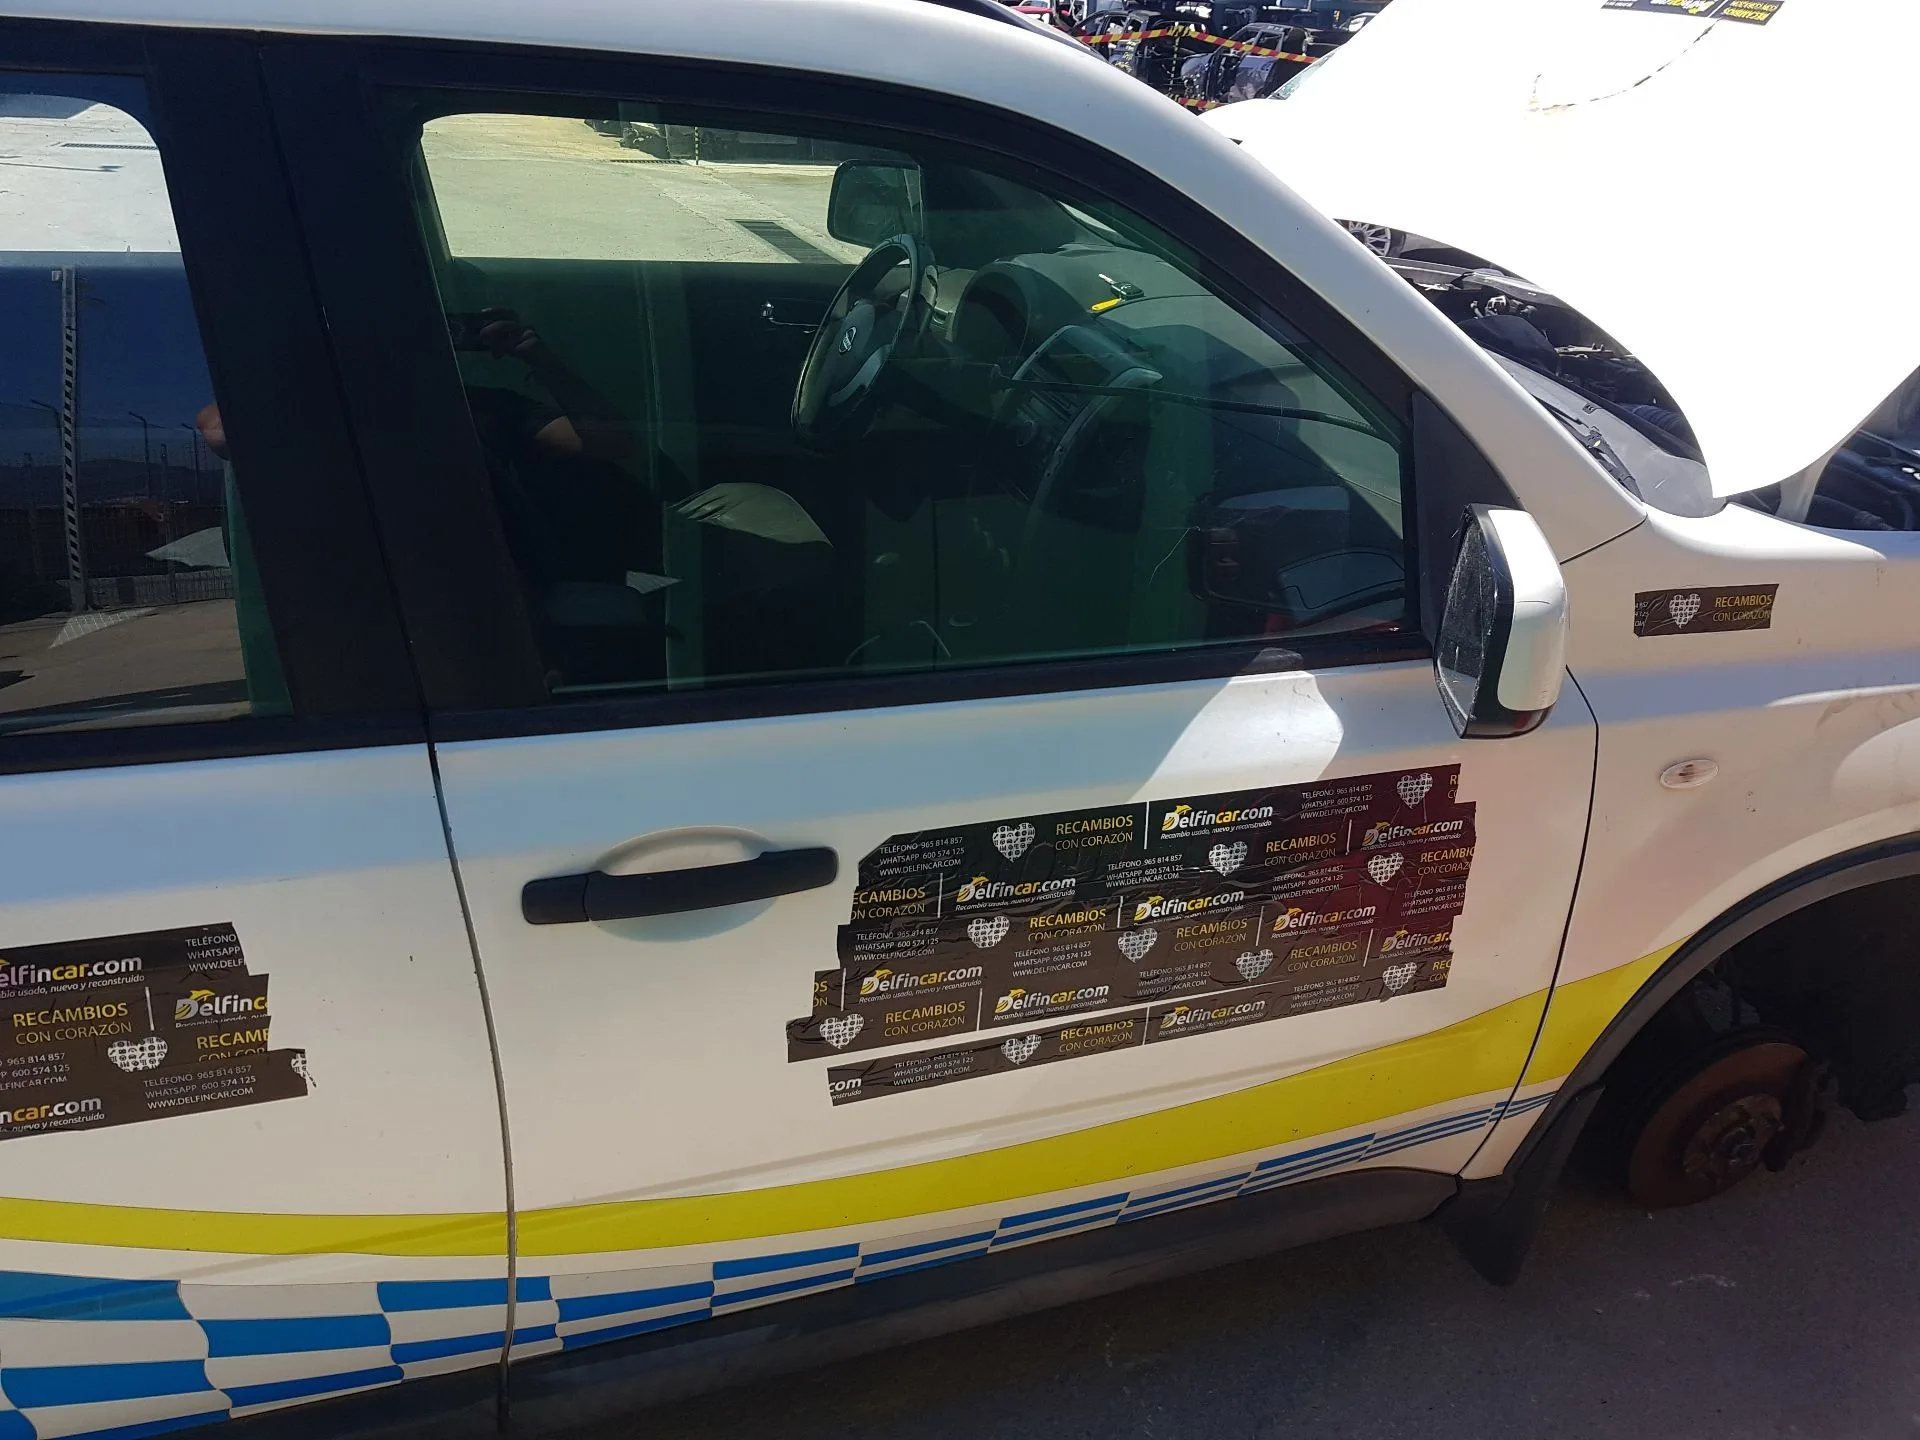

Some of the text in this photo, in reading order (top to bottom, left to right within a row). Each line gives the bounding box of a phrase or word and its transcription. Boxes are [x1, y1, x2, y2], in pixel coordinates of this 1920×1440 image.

[1715, 594, 1773, 608] RECAMBIOS
[1713, 612, 1730, 622] CON
[1056, 814, 1133, 836] RECAMBIOS
[1162, 805, 1273, 831] Delfincar.com
[1055, 832, 1133, 850] CON CORAZÓN
[1161, 831, 1190, 840] Recambio
[1362, 820, 1464, 846] Delfincar.com
[880, 837, 964, 855] TELÉFONO 965 814 857
[1266, 832, 1336, 854] RECAMBIOS
[880, 847, 964, 866] WHATSAPP 600 574 125
[1264, 856, 1286, 866] CON
[1418, 866, 1436, 876] CON
[956, 878, 1076, 903] Delfincar.com
[868, 904, 925, 918] CORAZÓN
[956, 902, 986, 911] Recambio
[1134, 890, 1244, 921] Delfincar.com
[1030, 908, 1106, 928] RECAMBIOS
[1273, 906, 1376, 931] Delfincar.com
[1176, 918, 1248, 938] RECAMBIOS
[184, 933, 237, 948] TELÉFONO
[855, 938, 939, 952] WHATSAPP 600 574 125
[1174, 932, 1246, 952] CON CORAZÓN
[1290, 940, 1358, 959] RECAMBIOS
[187, 945, 241, 961] WHATSAPP
[1013, 950, 1092, 968] WHATSAPP 600 574 125
[1288, 954, 1356, 972] CON CORAZÓN
[18, 974, 145, 996] usado, nuevo y reconstruido
[860, 966, 982, 995] Delfincar.com
[859, 992, 892, 1004] Recambio
[893, 990, 914, 999] usado,
[942, 979, 981, 990] reconstruido
[994, 985, 1109, 1014] Delfincar.com
[13, 1002, 128, 1027] RECAMBIOS
[885, 1001, 966, 1023] RECAMBIOS
[994, 1012, 1024, 1021] Recambio
[1160, 1000, 1265, 1028] Delfincar.com
[16, 1021, 132, 1045] CON CORAZÓN
[884, 1016, 965, 1037] CON CORAZÓN
[1060, 1020, 1134, 1040] RECAMBIOS
[1159, 1026, 1186, 1036] Recambio
[1060, 1042, 1080, 1052] CON
[7, 1052, 65, 1066] 965 814 857
[12, 1064, 70, 1078] 600 574 125
[196, 1070, 214, 1080] 965
[216, 1067, 233, 1077] 814
[235, 1064, 252, 1075] 857
[144, 1075, 256, 1099] WHATSAPP 600 574 125
[147, 1086, 254, 1110] WWW.DELFINCAR.COM
[41, 1112, 104, 1129] y reconstruido
